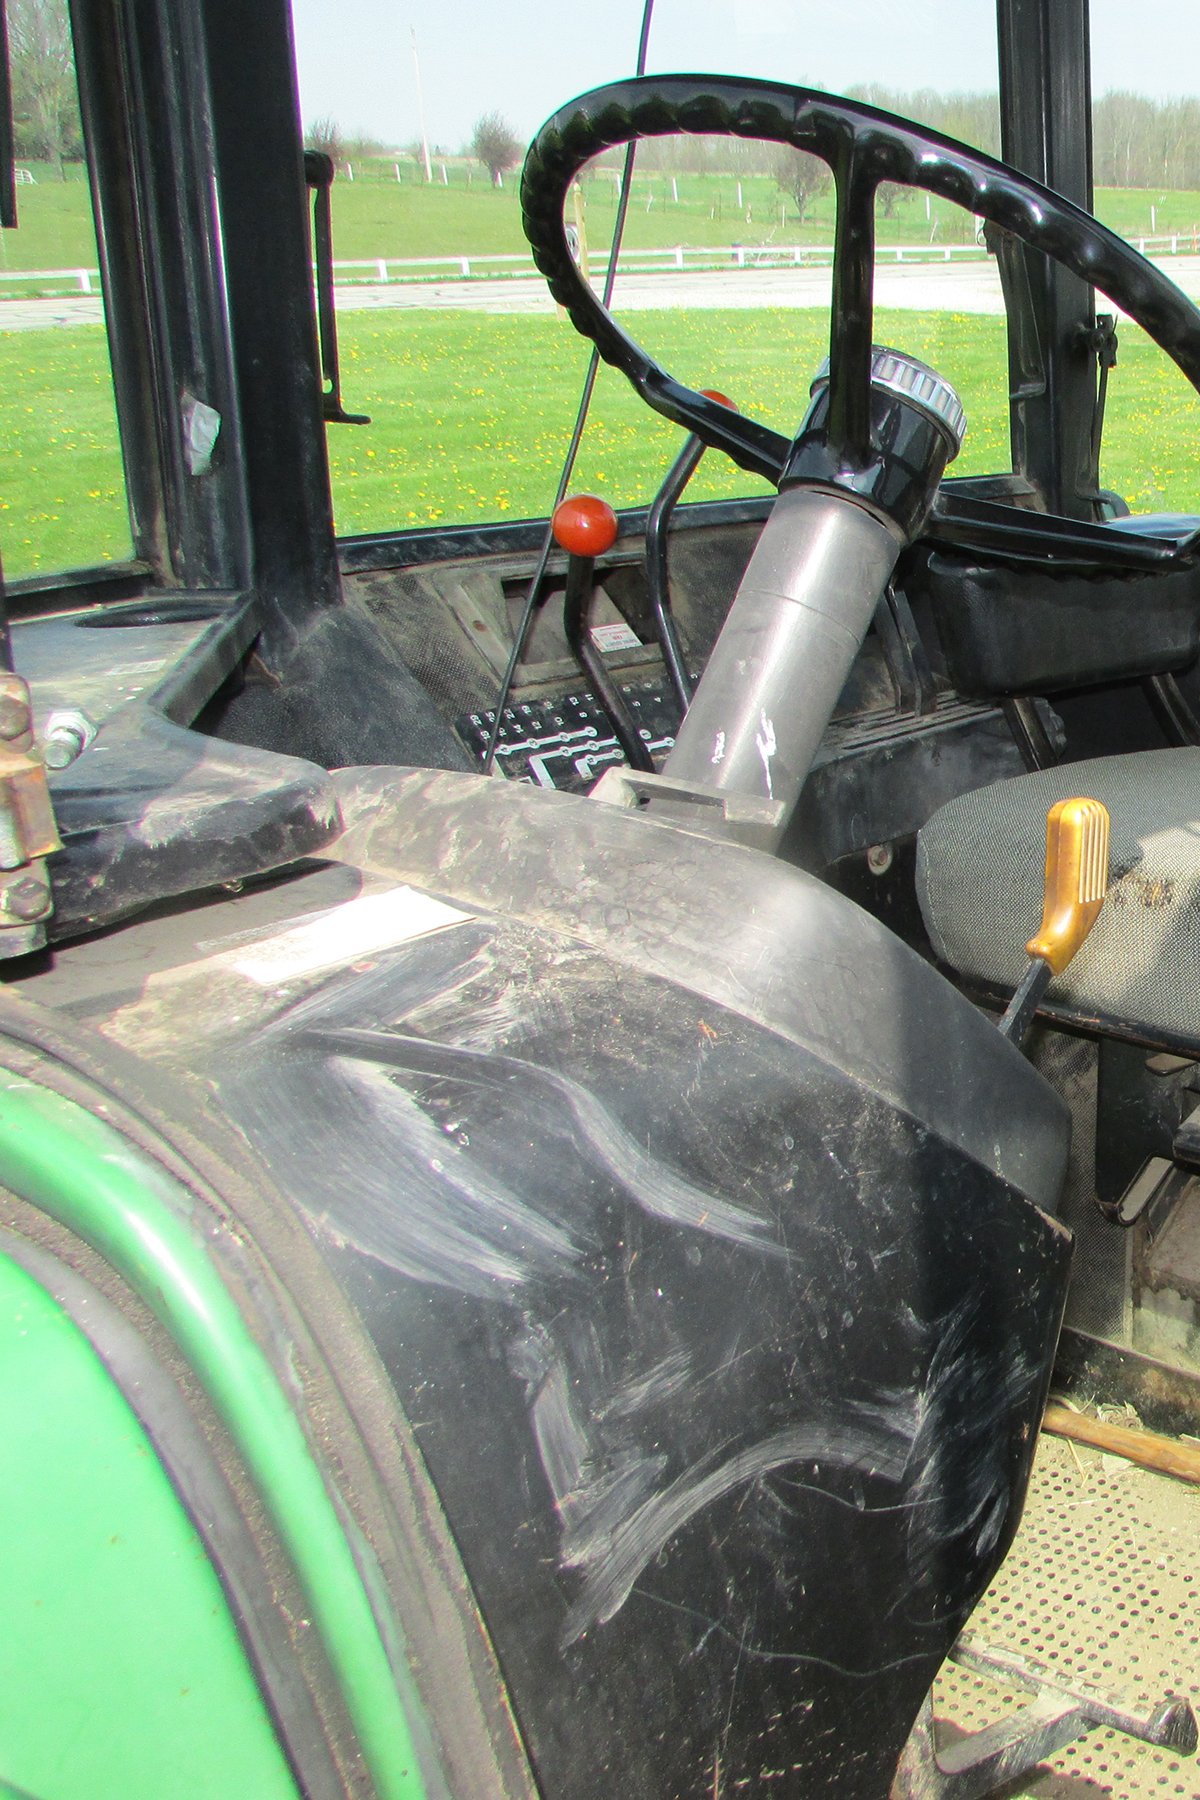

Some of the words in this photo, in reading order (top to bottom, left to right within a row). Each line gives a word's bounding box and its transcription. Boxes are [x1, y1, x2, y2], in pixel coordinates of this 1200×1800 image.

[569, 696, 579, 706] 13
[585, 693, 594, 702] 11
[503, 708, 515, 720] 22
[521, 705, 532, 716] 19
[470, 714, 482, 726] 29
[554, 716, 564, 726] 10
[513, 724, 524, 734] 14
[531, 721, 542, 730] 12
[480, 730, 491, 740] 18
